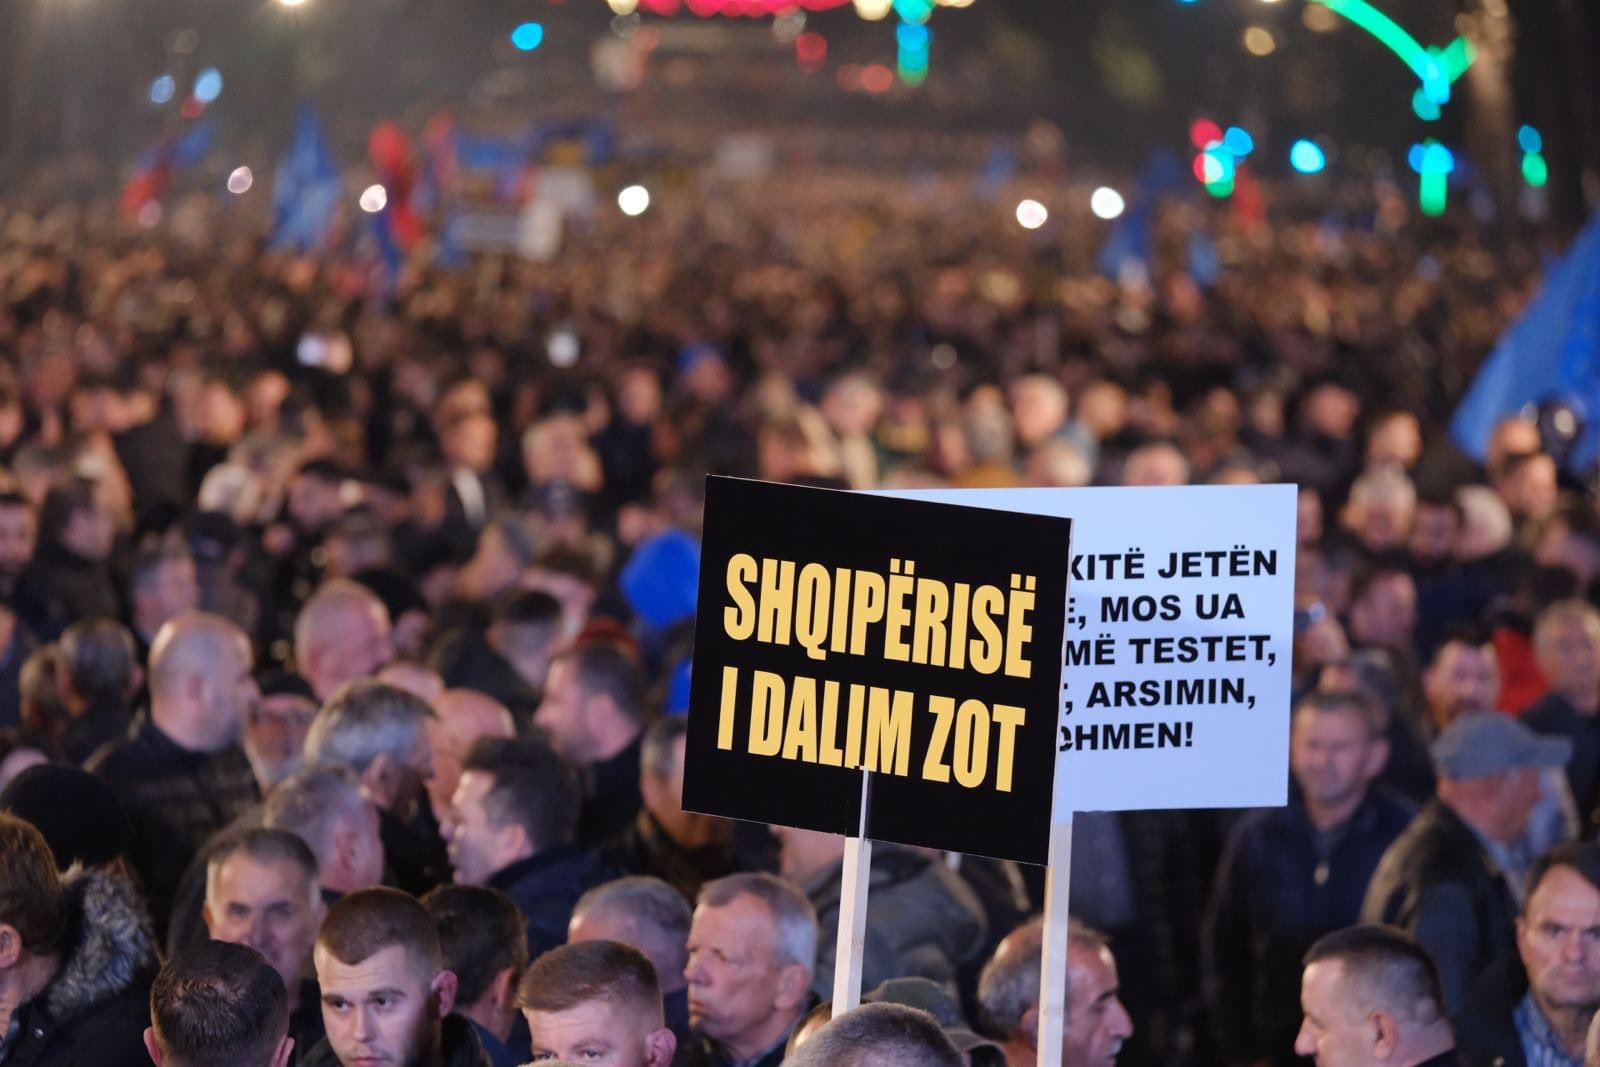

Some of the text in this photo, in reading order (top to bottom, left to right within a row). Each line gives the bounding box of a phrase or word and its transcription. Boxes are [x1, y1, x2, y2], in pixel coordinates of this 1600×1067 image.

[1157, 544, 1277, 579] JETËN
[723, 553, 1036, 679] SHQIPËRISË
[1100, 594, 1182, 623] MOS
[1195, 593, 1245, 620] UA
[1128, 634, 1276, 667] TESTET,
[1086, 677, 1256, 710] ARSIMIN,
[717, 666, 1026, 792] I DALIM ZOT
